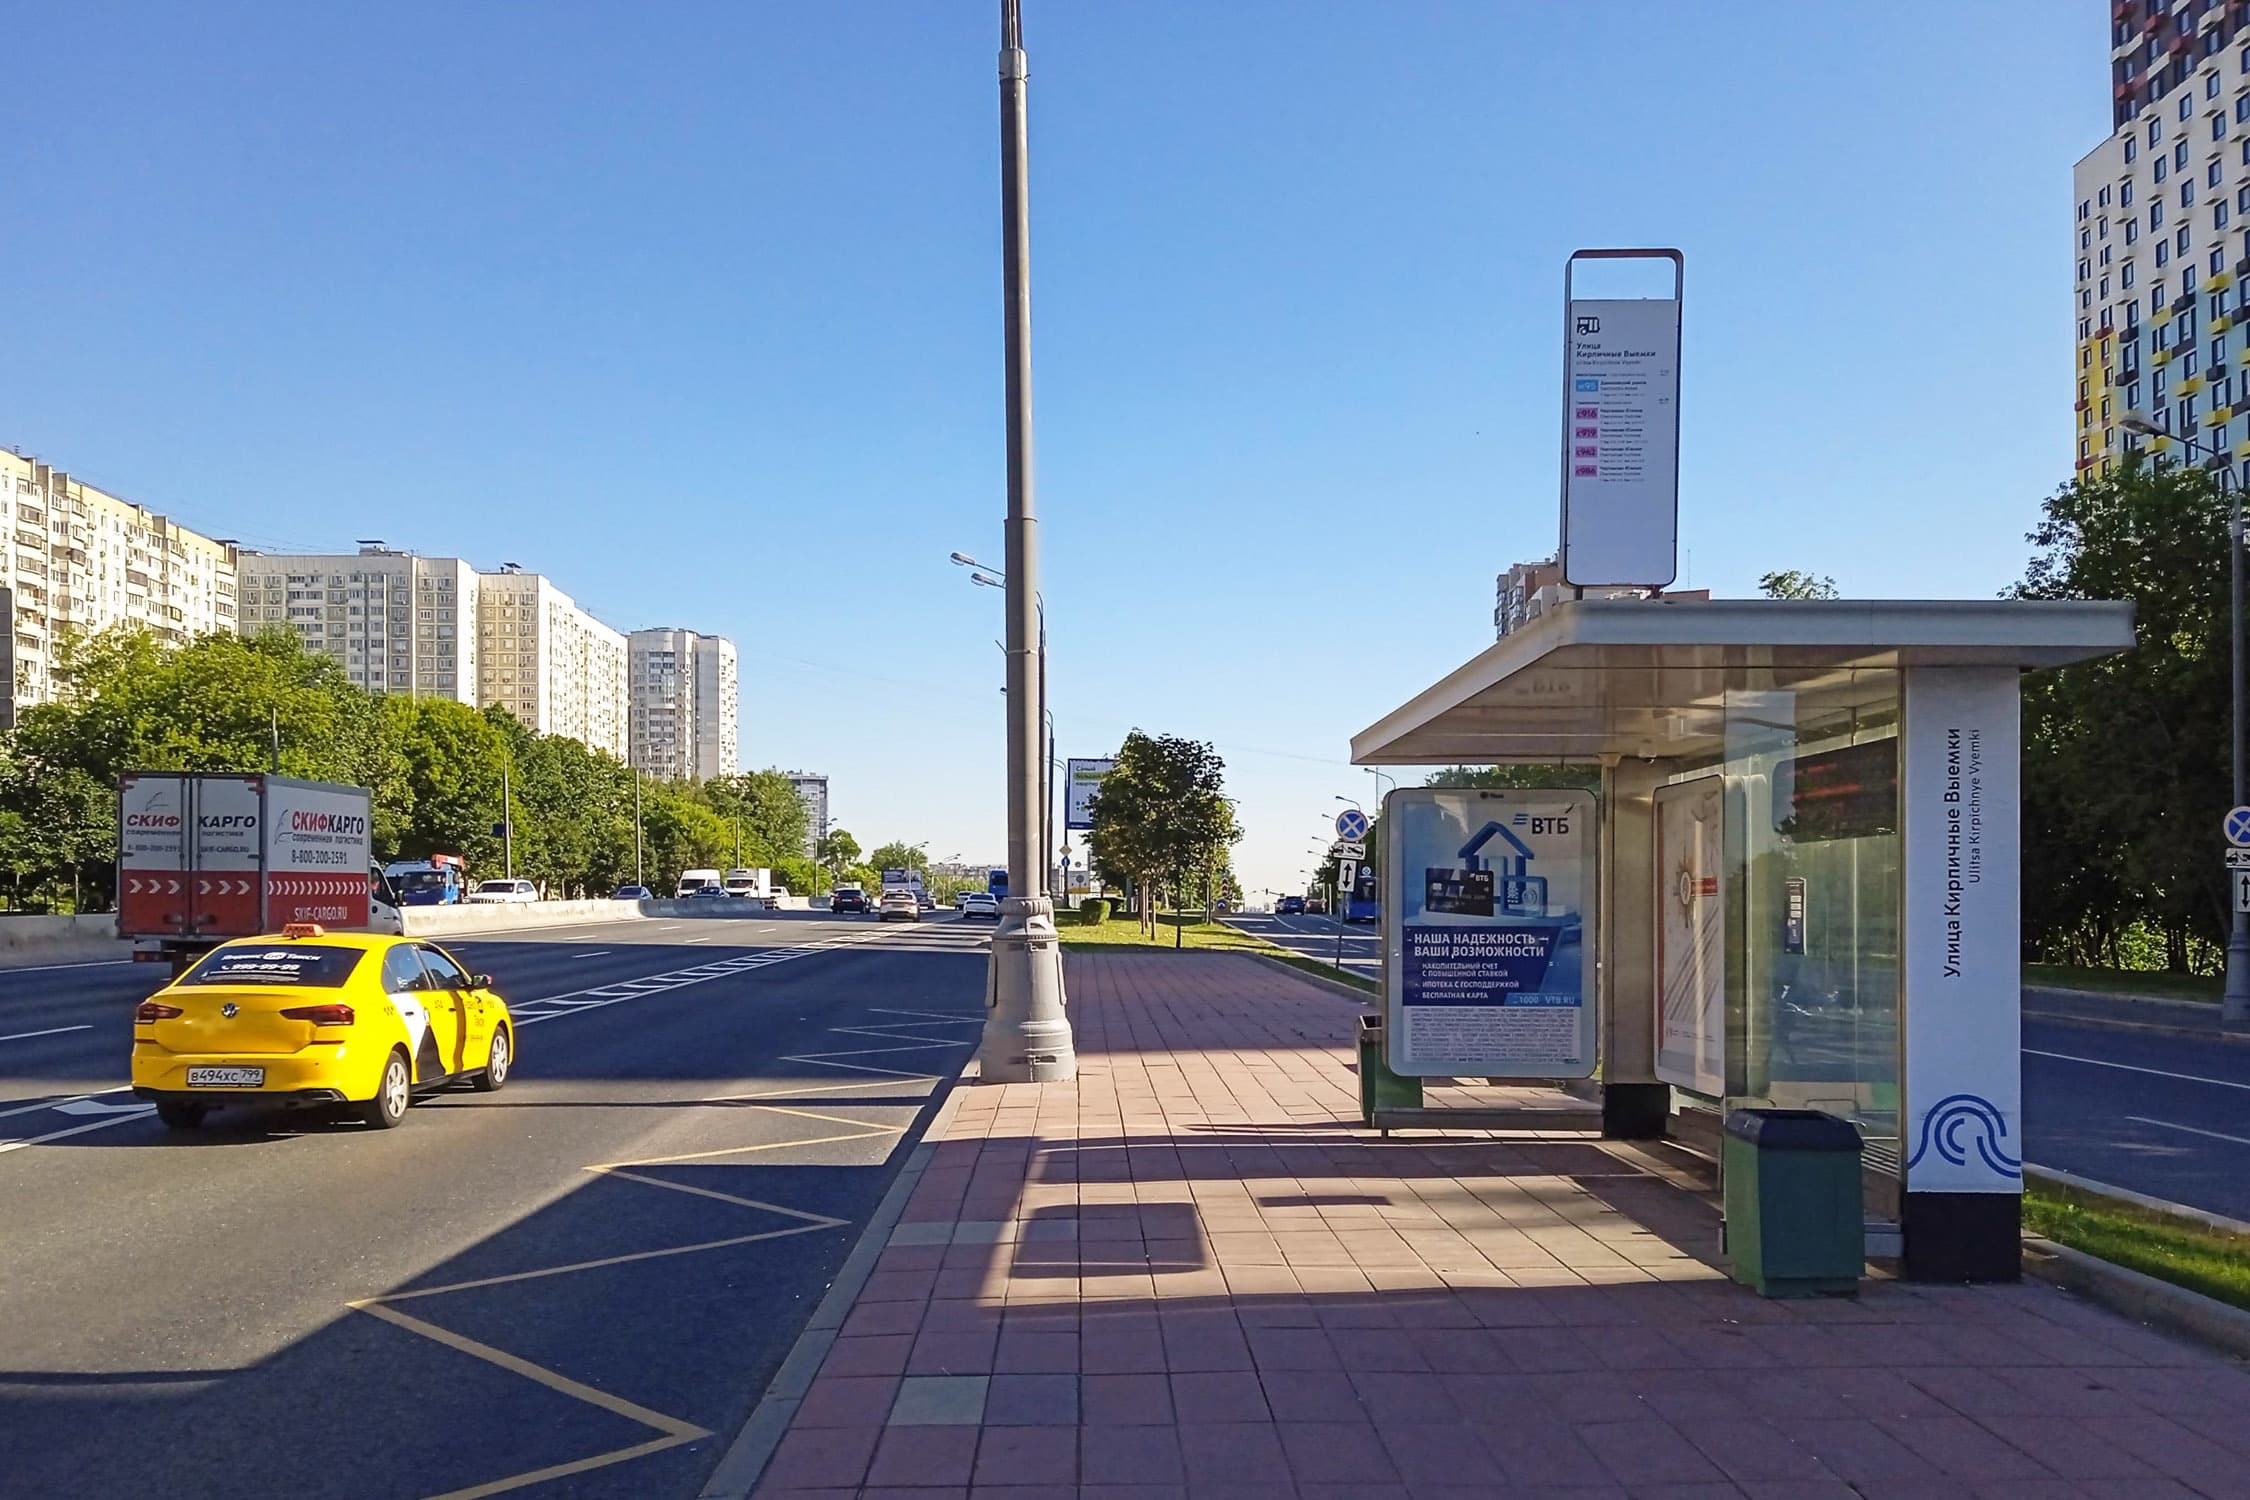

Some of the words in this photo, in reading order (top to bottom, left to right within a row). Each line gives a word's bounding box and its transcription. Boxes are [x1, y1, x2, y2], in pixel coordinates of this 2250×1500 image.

[1623, 350, 1656, 358] Выемки
[1968, 730, 1982, 775] Vyemki
[1944, 729, 1960, 803] Выемки
[126, 814, 181, 828] СКИФ
[198, 815, 257, 828] КАРГО
[292, 811, 364, 835] СКИФКАРГО
[1968, 778, 1982, 844] Kirpichnye
[1531, 817, 1570, 835] ВТБ
[1944, 808, 1964, 916] Кирпичные
[1969, 847, 1981, 883] Ulitsa
[1414, 933, 1451, 945] НАША
[1453, 933, 1536, 946] НАДЕЖНОСТЬ
[1414, 946, 1450, 957] ВАШИ
[1453, 945, 1544, 957] ВОЗМОЖНОСТИ
[1944, 920, 1963, 978] Улица
[240, 1069, 260, 1079] 799
